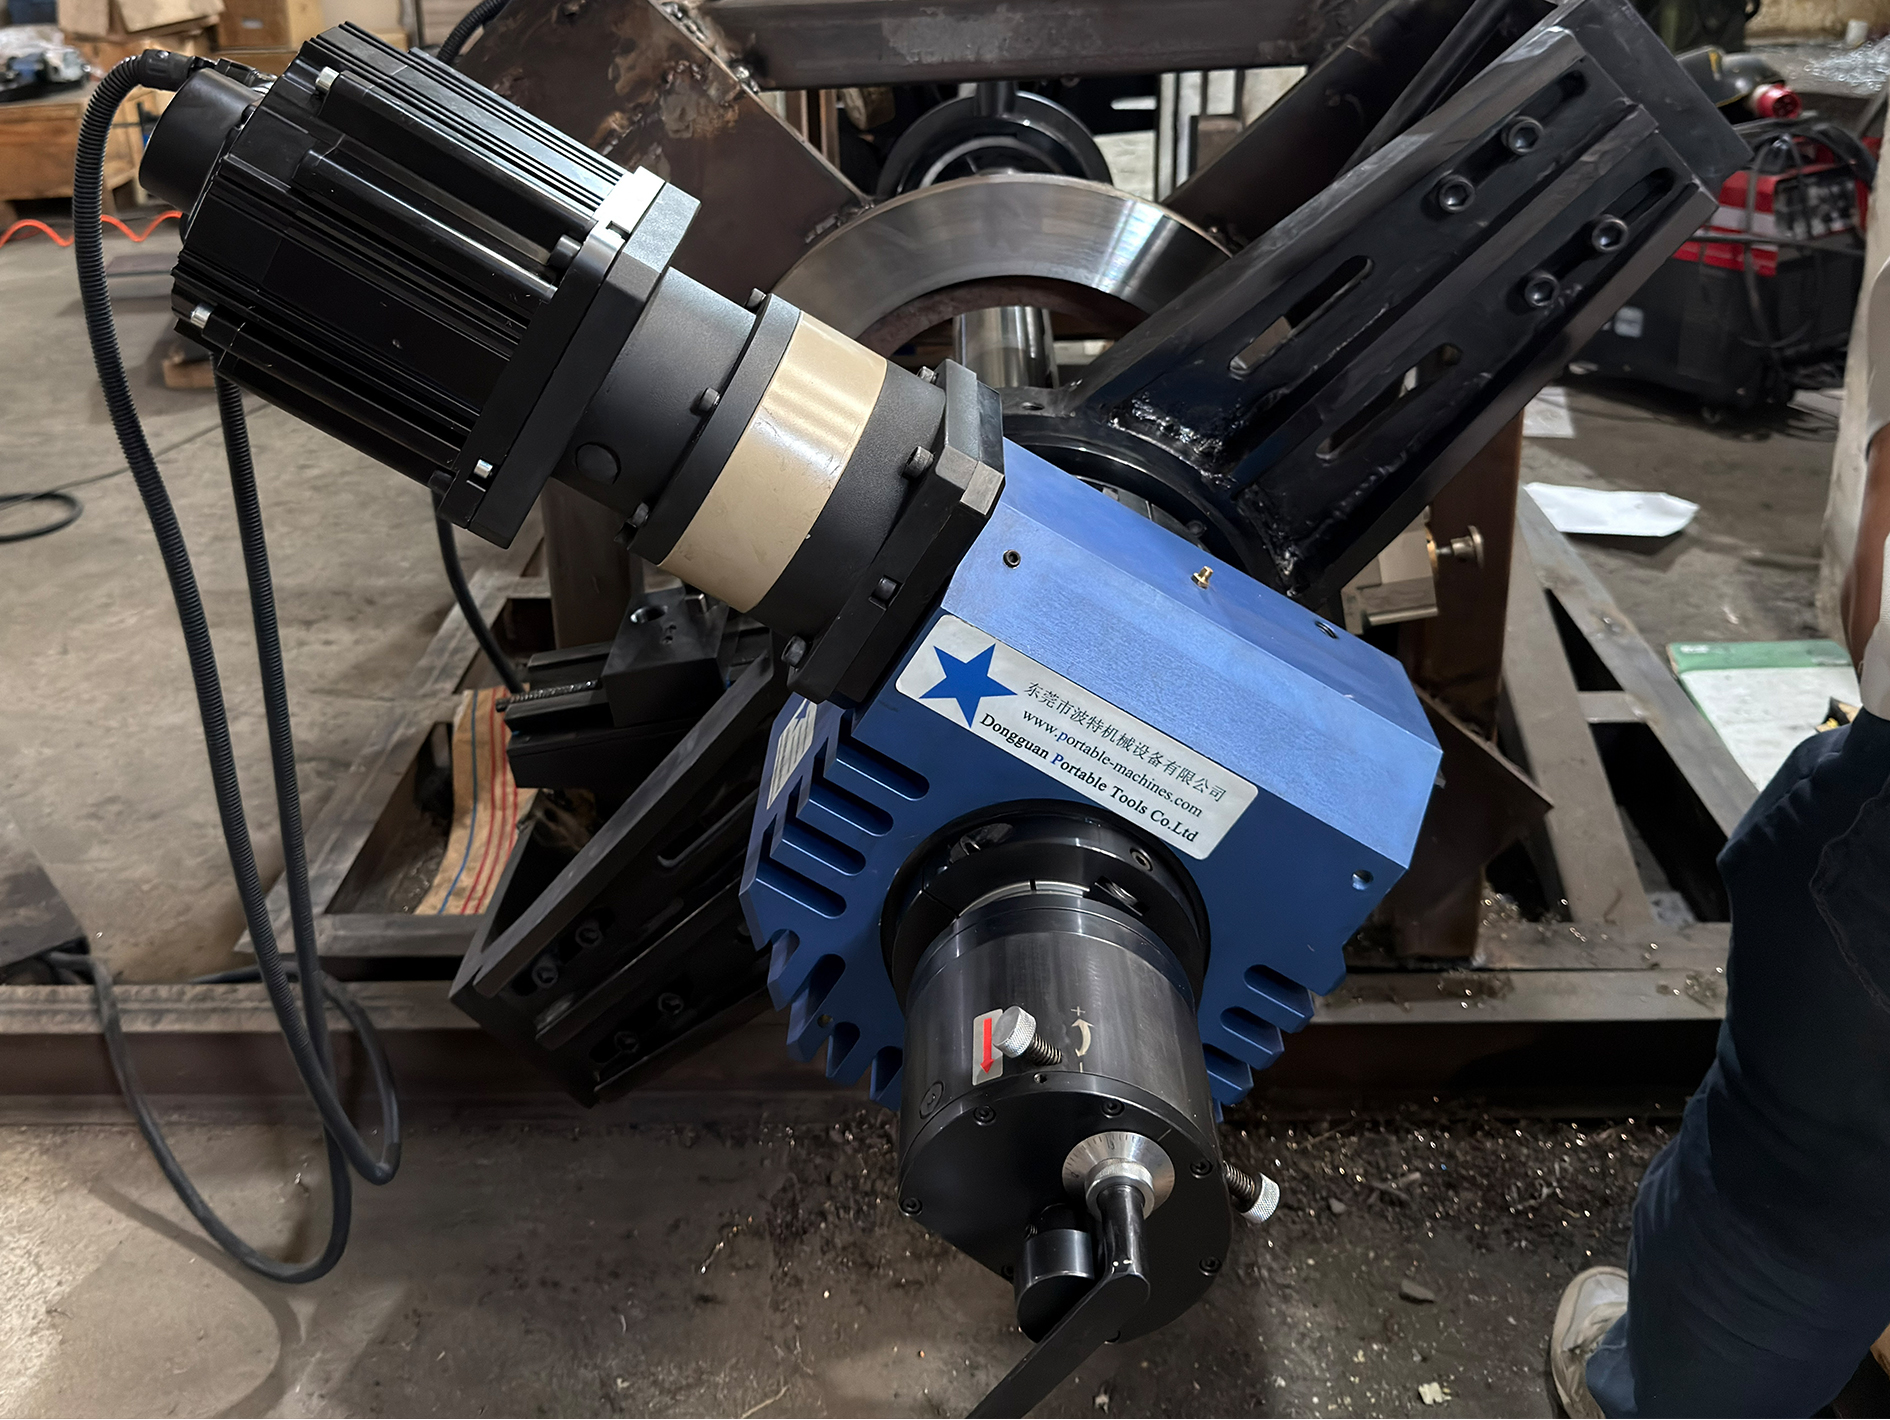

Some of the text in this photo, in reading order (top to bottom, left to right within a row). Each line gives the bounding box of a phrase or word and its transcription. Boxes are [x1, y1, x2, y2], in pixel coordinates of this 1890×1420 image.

[979, 712, 1199, 842] Dongguan Portable Tools Co.Ltd
[1023, 681, 1227, 802] 东莞市波特机械设备有限公司
[1023, 710, 1203, 817] www.portable-machines.com
